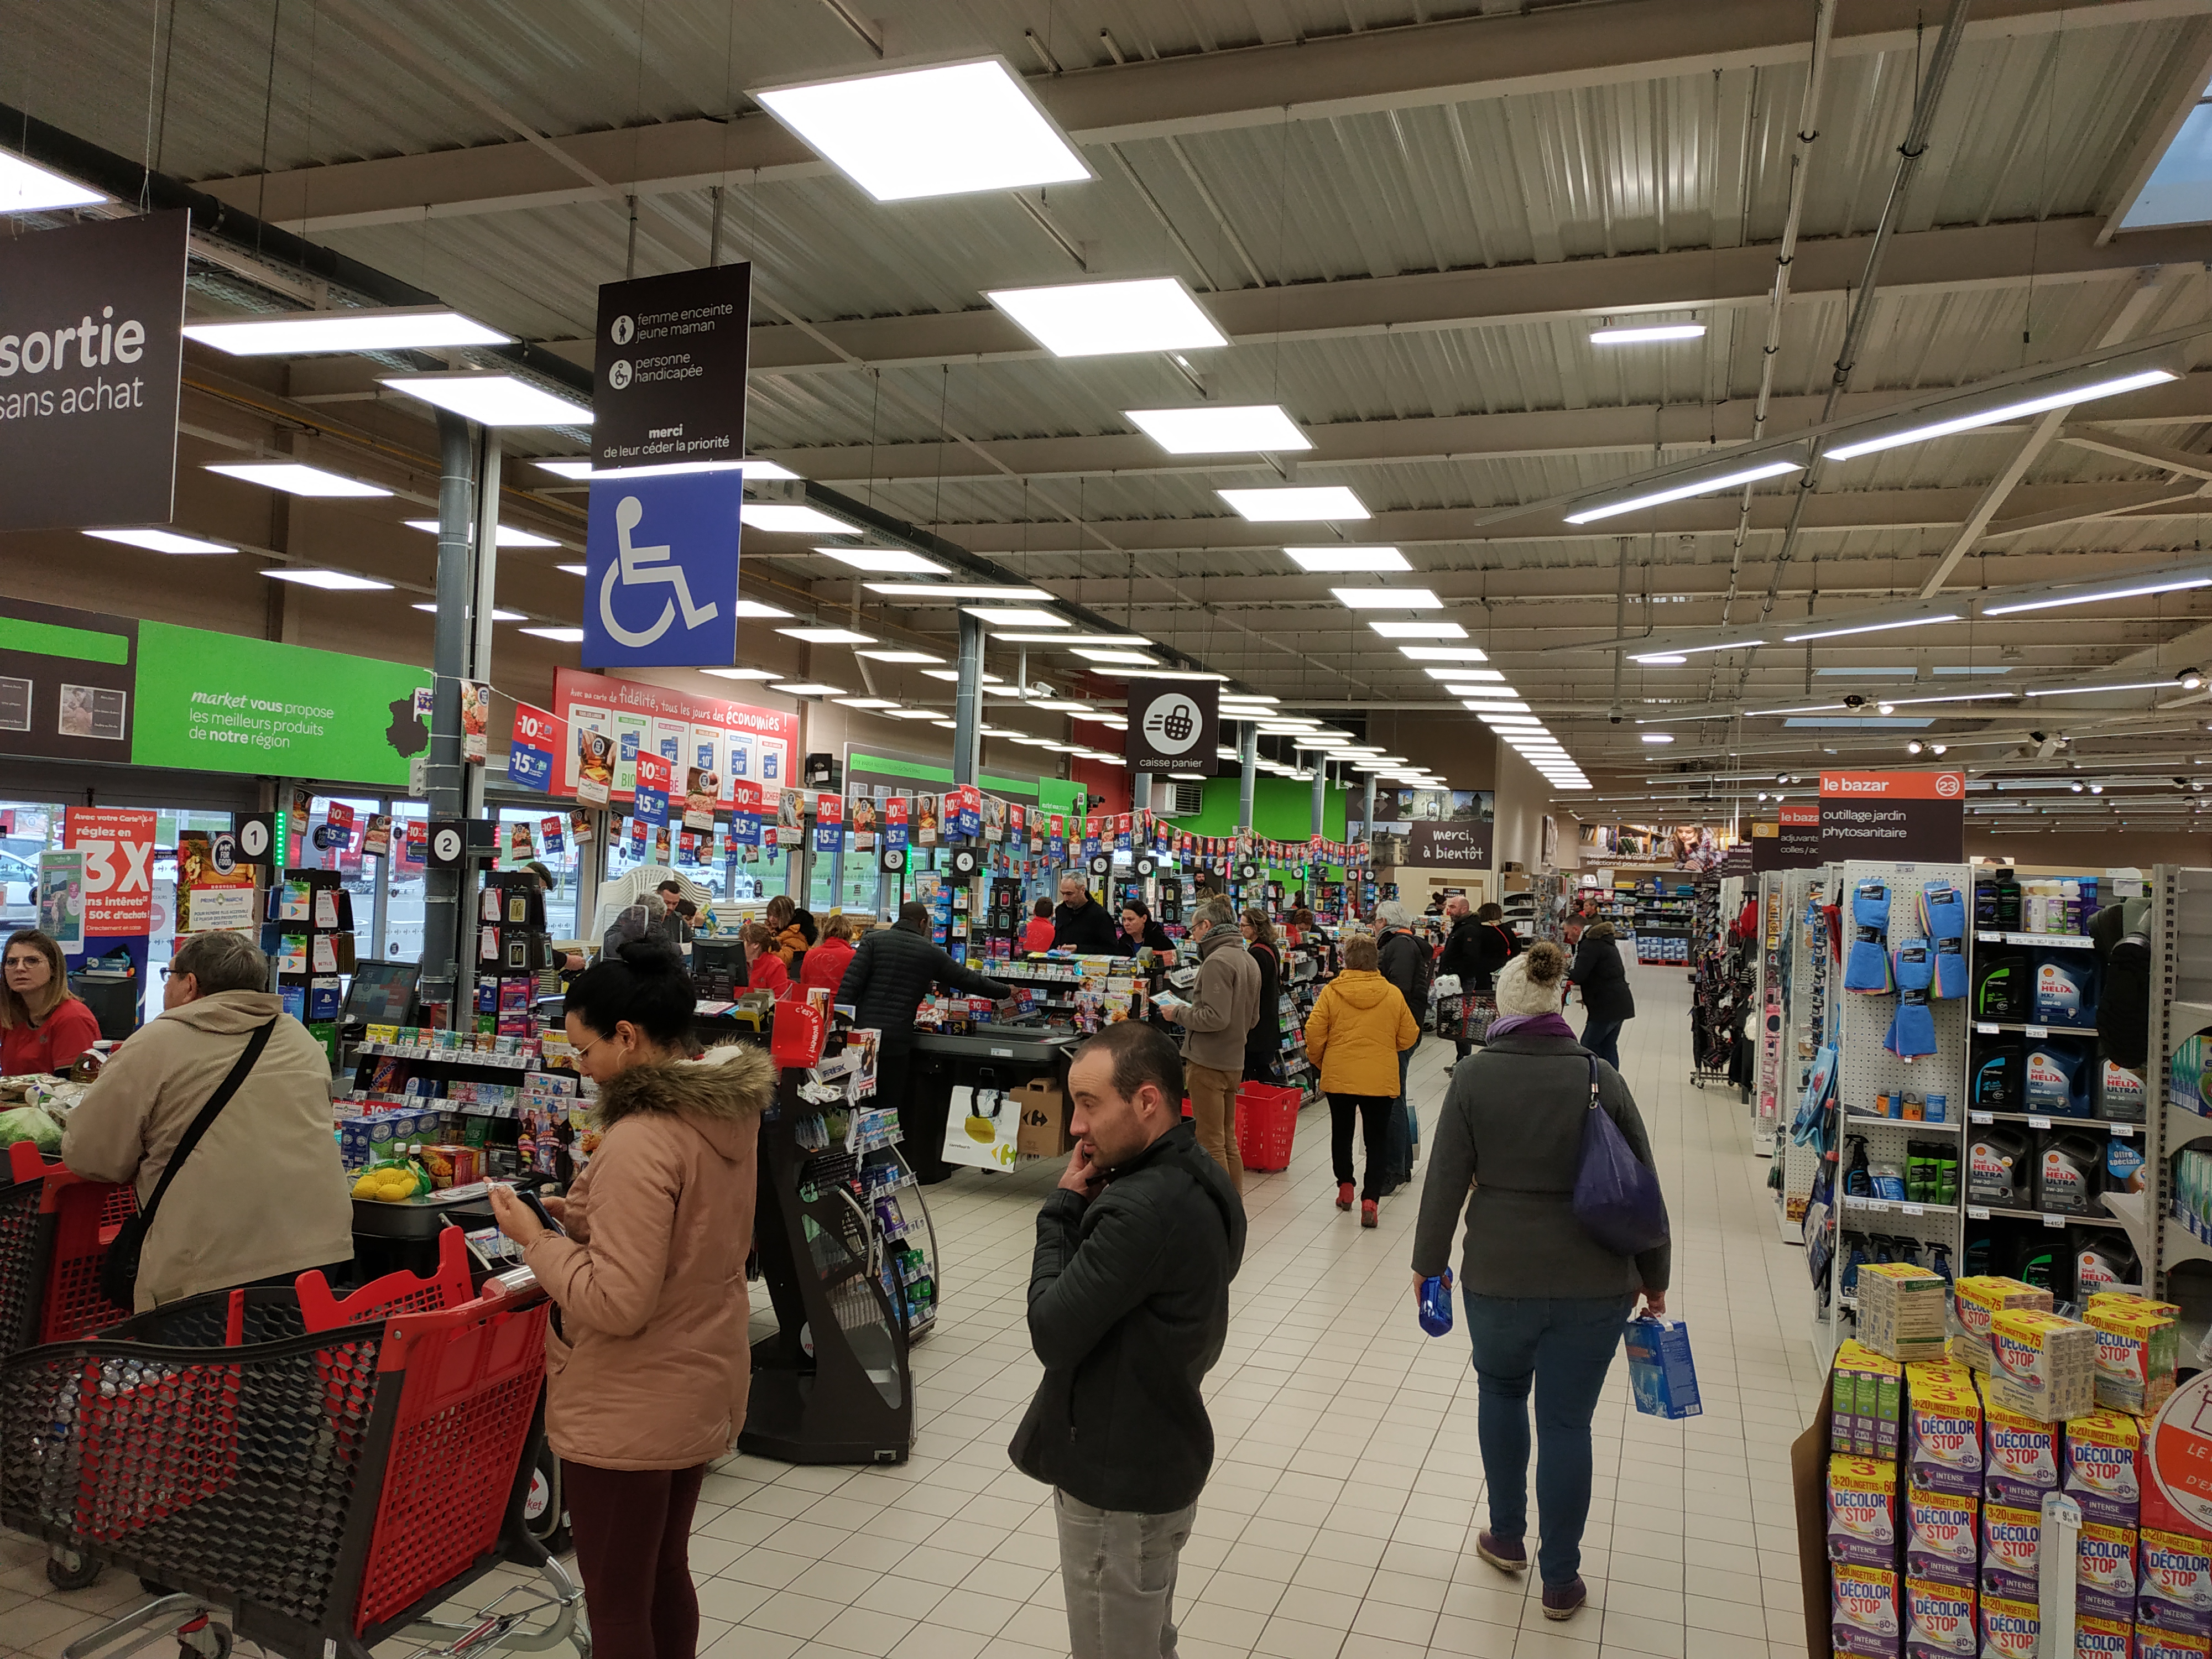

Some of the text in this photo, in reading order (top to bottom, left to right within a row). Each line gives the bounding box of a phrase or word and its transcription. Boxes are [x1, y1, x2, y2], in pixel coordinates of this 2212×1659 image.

[637, 304, 733, 326] femme enceinte
[635, 321, 715, 343] jeune maman
[0, 306, 145, 376] sortie
[635, 353, 690, 371] personne
[635, 364, 703, 382] handicapée
[61, 377, 144, 413] achat
[649, 424, 683, 439] merci
[604, 435, 729, 458] de leur céder la priorité
[191, 692, 334, 719] market vous propose
[570, 688, 583, 697] Avec
[609, 691, 617, 703] de
[619, 685, 658, 712] fidélité,
[661, 700, 678, 714] tous
[680, 703, 690, 716] les
[692, 706, 710, 719] jours
[712, 708, 724, 722] des
[726, 706, 780, 731] économies
[190, 708, 324, 735] les meilleurs produits
[189, 726, 290, 749] de notre région
[1140, 758, 1203, 769] caisse panier
[1824, 778, 1889, 791] le bazar
[1939, 782, 1957, 791] 23
[1781, 812, 1819, 822] le baza
[1823, 809, 1906, 823] outillage jardin
[76, 826, 116, 838] réglez
[250, 830, 258, 846] 1
[1433, 830, 1474, 844] merci,
[1781, 834, 1819, 844] adjuvants
[1822, 827, 1907, 839] phytosanitaire
[443, 838, 452, 852] 2
[1423, 844, 1484, 860] à bientôt
[890, 854, 897, 863] 3
[89, 911, 111, 919] 50€
[2041, 985, 2073, 994] HELIX
[795, 1005, 819, 1053] c'est le moment
[822, 1062, 847, 1077] FRISK
[2030, 1073, 2063, 1082] HELIX
[2109, 1157, 2141, 1166] spéciale
[2114, 1150, 2133, 1159] Offre
[1973, 1164, 2005, 1173] HELIX
[1973, 1170, 2003, 1179] ULTRA
[2046, 1171, 2079, 1180] HELIX
[2008, 1352, 2035, 1368] STOP
[1931, 1401, 1960, 1416] LINGETTES
[1965, 1405, 1976, 1418] 60
[1921, 1417, 1976, 1435] DÉCOLOR
[1932, 1435, 1964, 1450] STOP
[1996, 1430, 2051, 1449] DÉCOLOR
[2006, 1449, 2039, 1464] STOP
[2075, 1443, 2133, 1465] DÉCOLOR
[2187, 1443, 2208, 1459] LE
[1936, 1472, 1965, 1483] INTENSE
[2085, 1463, 2121, 1479] STOP
[1835, 1489, 1886, 1508] DÉCOLOR
[2009, 1486, 2039, 1498] INTENSE
[1845, 1507, 1876, 1522] STOP
[1916, 1506, 1970, 1526] DÉCOLOR
[1927, 1525, 1959, 1540] STOP
[1850, 1545, 1877, 1555] INTENSE
[2150, 1548, 2210, 1572] DÉCOLOR
[1931, 1562, 1959, 1574] INTENSE
[2161, 1570, 2197, 1587] STOP
[1840, 1579, 1891, 1599] DÉCOLOR
[1850, 1598, 1881, 1614] STOP
